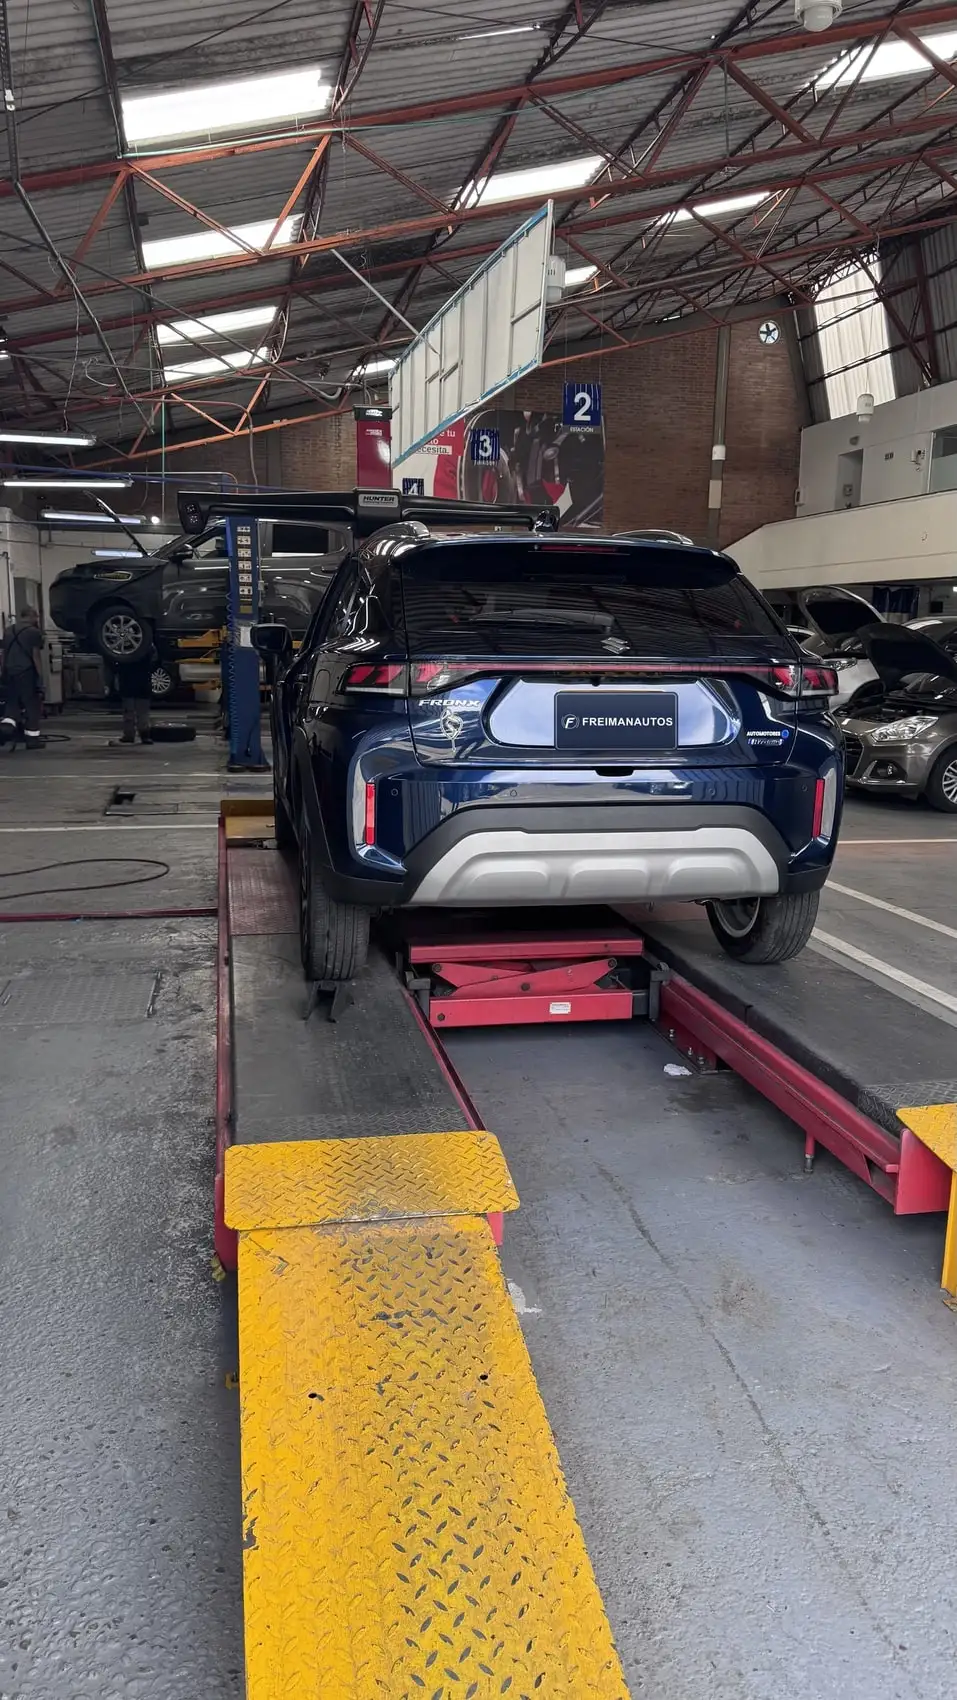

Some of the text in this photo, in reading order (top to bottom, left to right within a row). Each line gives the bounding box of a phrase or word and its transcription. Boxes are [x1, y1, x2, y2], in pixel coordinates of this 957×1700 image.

[574, 392, 591, 421] 2
[447, 429, 456, 438] tu
[416, 446, 450, 454] ecesita.
[479, 434, 493, 457] 3
[418, 699, 480, 707] FRONX
[582, 717, 673, 727] FREIMANAUTOS
